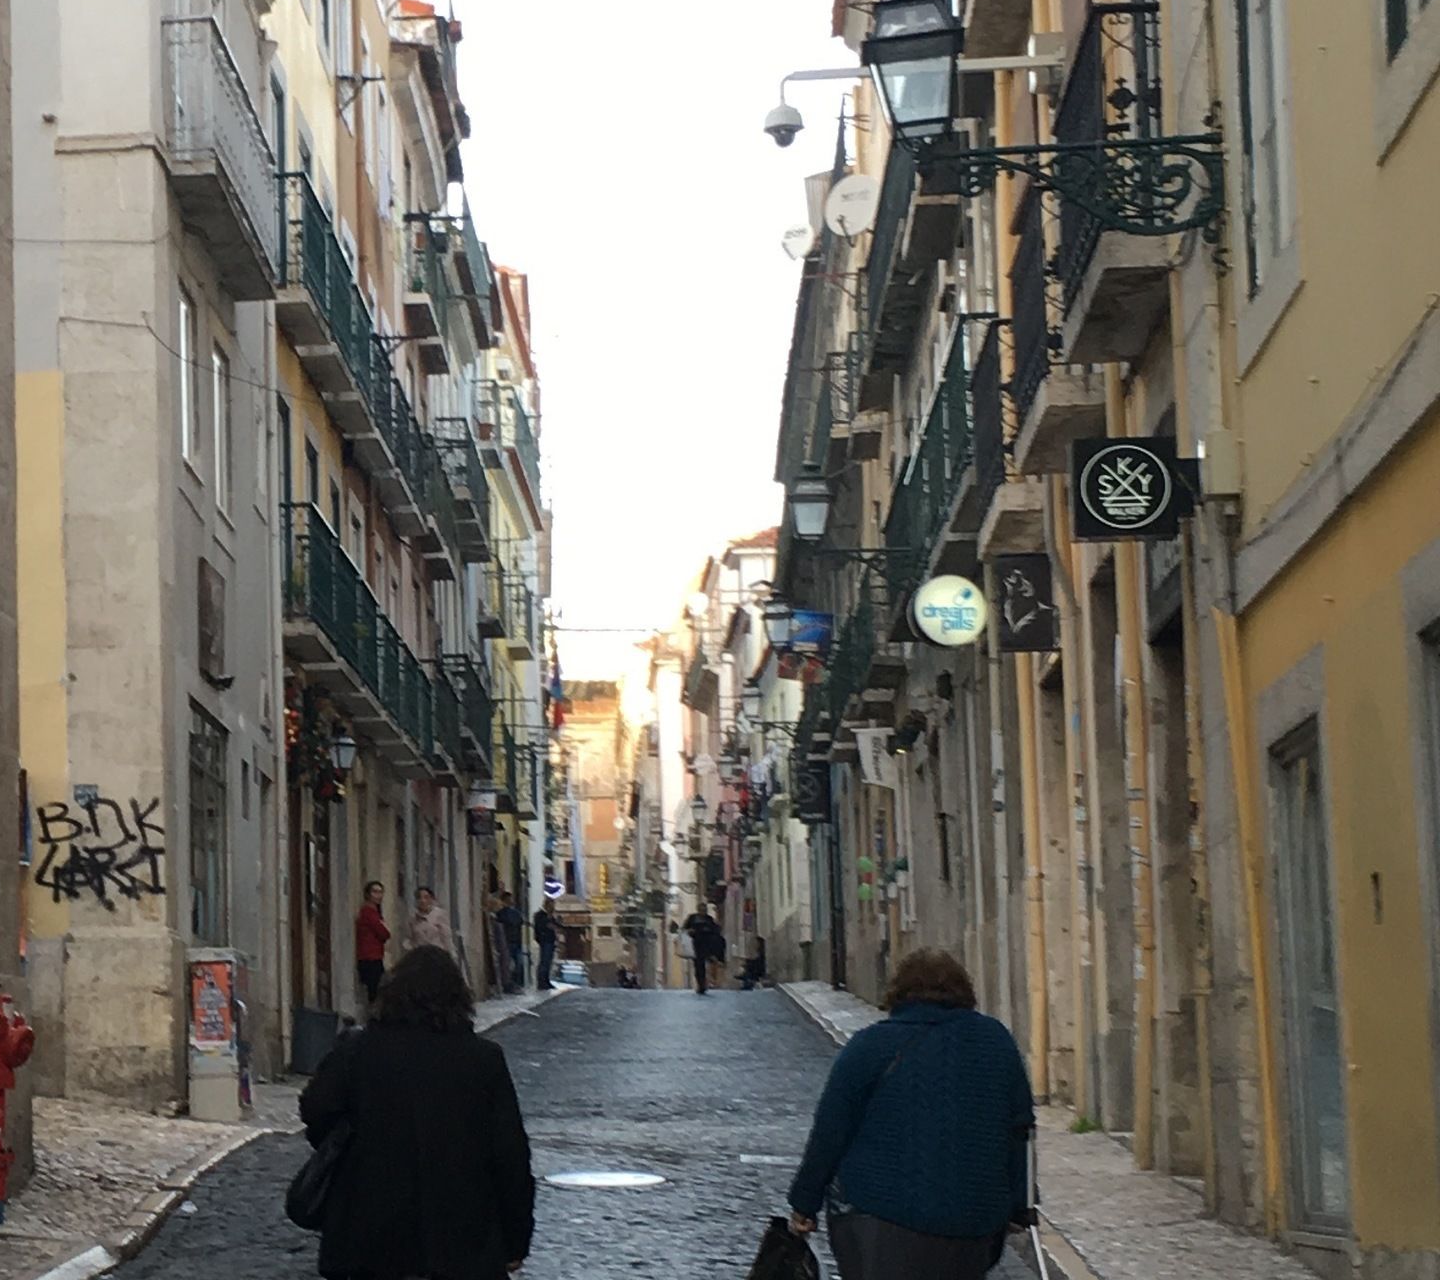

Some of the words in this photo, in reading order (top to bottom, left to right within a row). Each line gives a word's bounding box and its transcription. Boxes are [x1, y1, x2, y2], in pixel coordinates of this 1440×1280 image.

[1098, 457, 1153, 495] SKY
[922, 604, 977, 618] dream
[942, 617, 975, 634] pills
